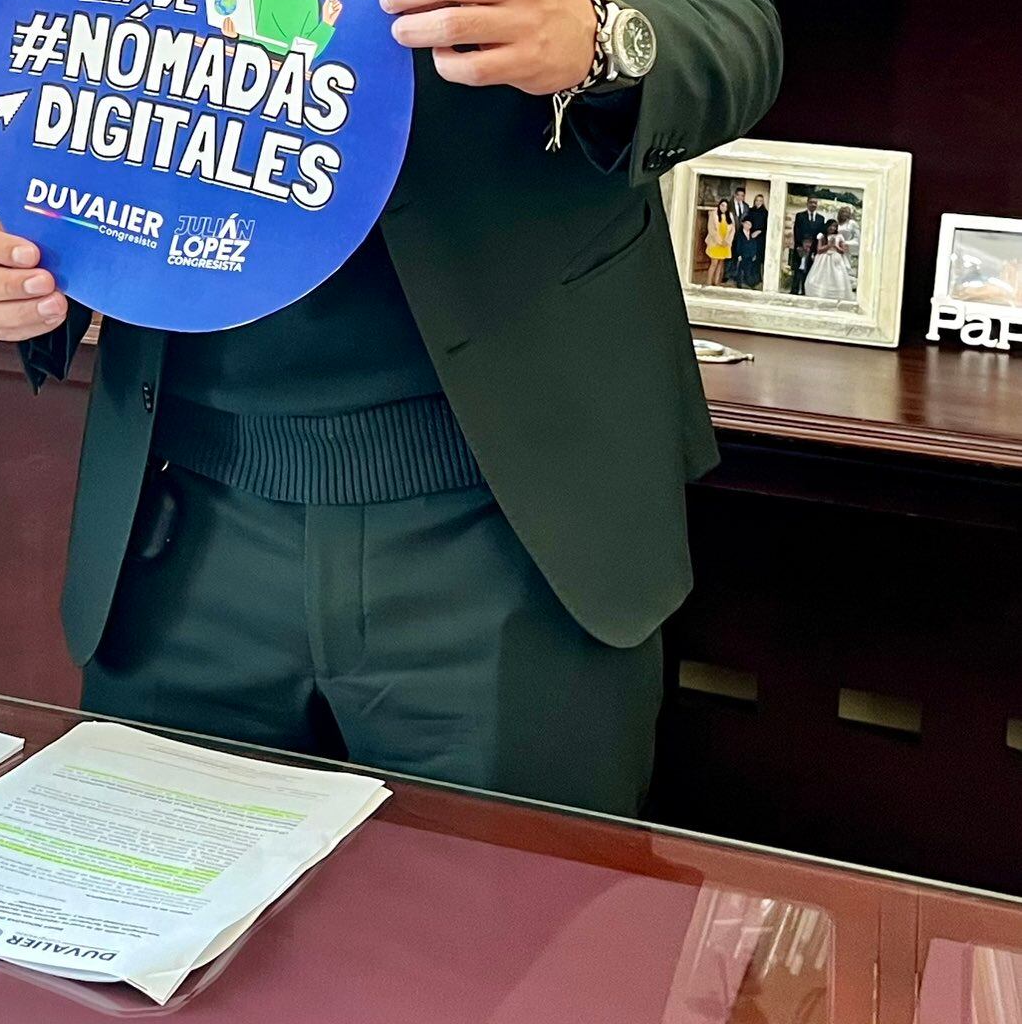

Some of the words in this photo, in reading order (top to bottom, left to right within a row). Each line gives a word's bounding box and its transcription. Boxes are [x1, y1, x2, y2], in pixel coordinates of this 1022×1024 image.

[9, 3, 356, 137] #NÓMADAS
[33, 84, 341, 211] DIGITALES
[26, 178, 164, 238] DUVALIER
[98, 224, 158, 249] Congresista
[174, 213, 255, 240] JULIÁN
[167, 255, 242, 272] CONGRESISTA
[6, 934, 118, 961] DUVALIER
